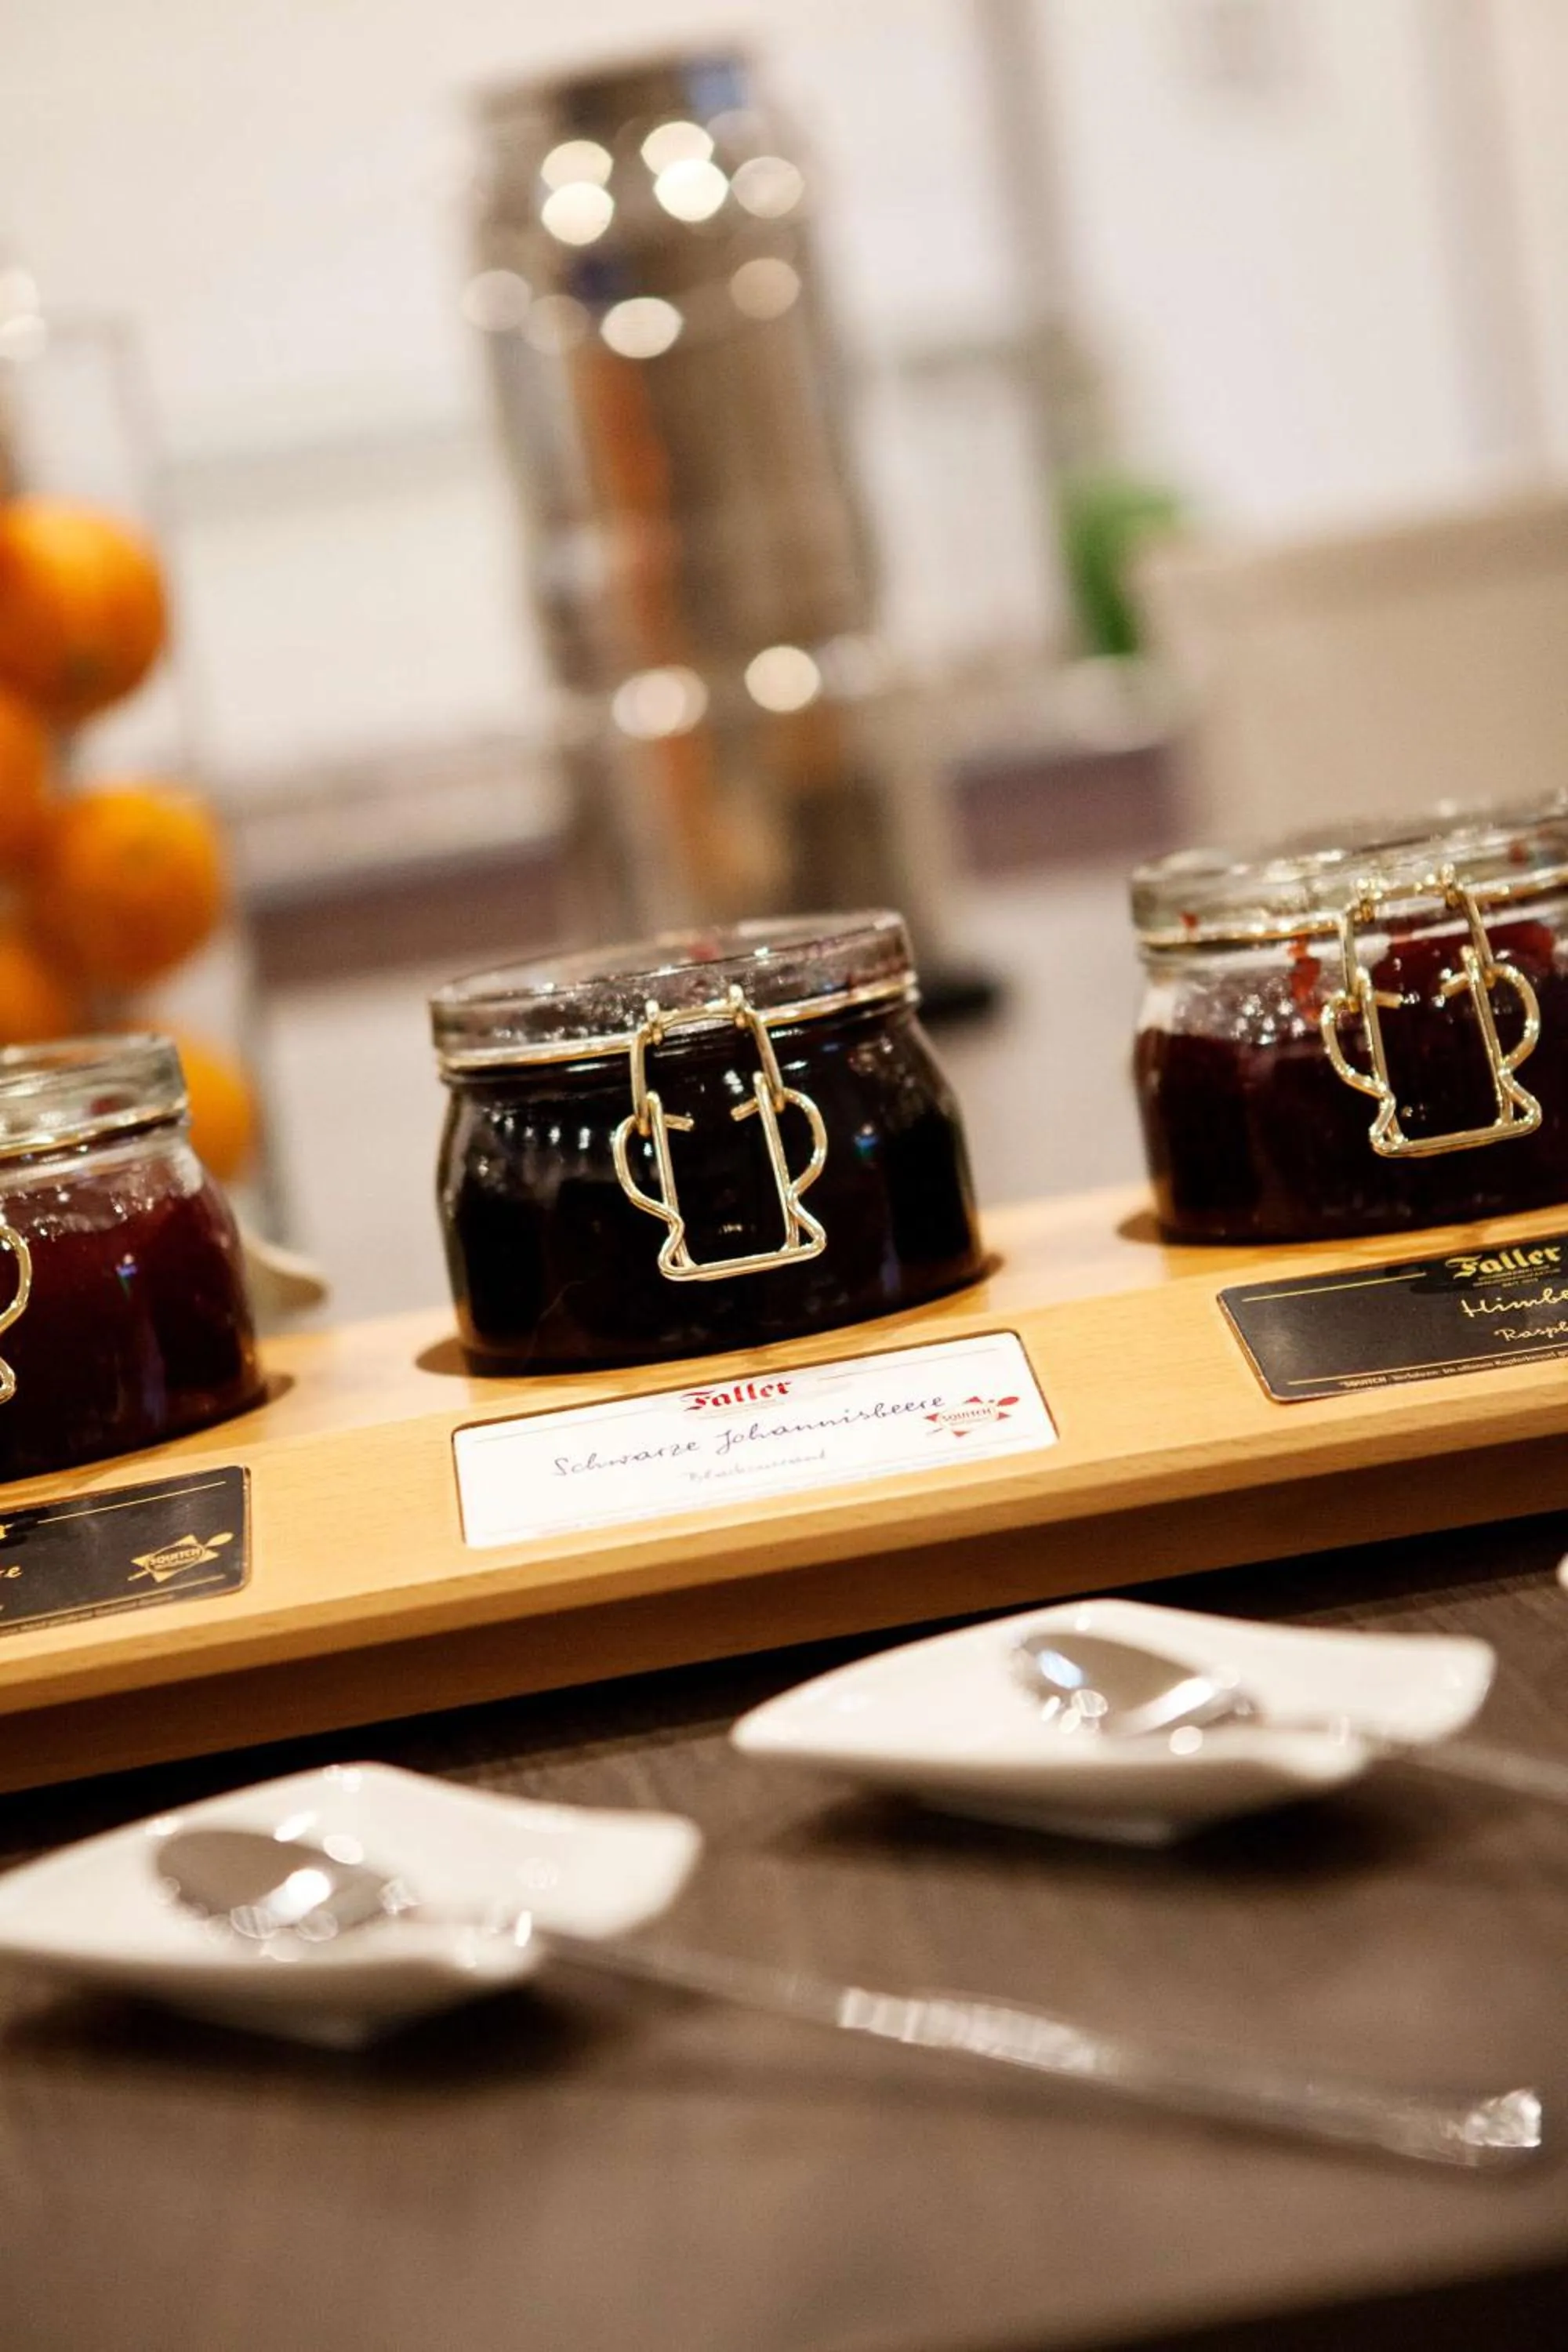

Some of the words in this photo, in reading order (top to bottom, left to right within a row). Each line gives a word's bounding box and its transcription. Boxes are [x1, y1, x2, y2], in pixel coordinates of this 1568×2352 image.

[1445, 1247, 1561, 1279] Faller
[680, 1381, 792, 1410] Faller
[552, 1442, 699, 1475] Schwarze
[716, 1396, 946, 1455] Johannisbeere
